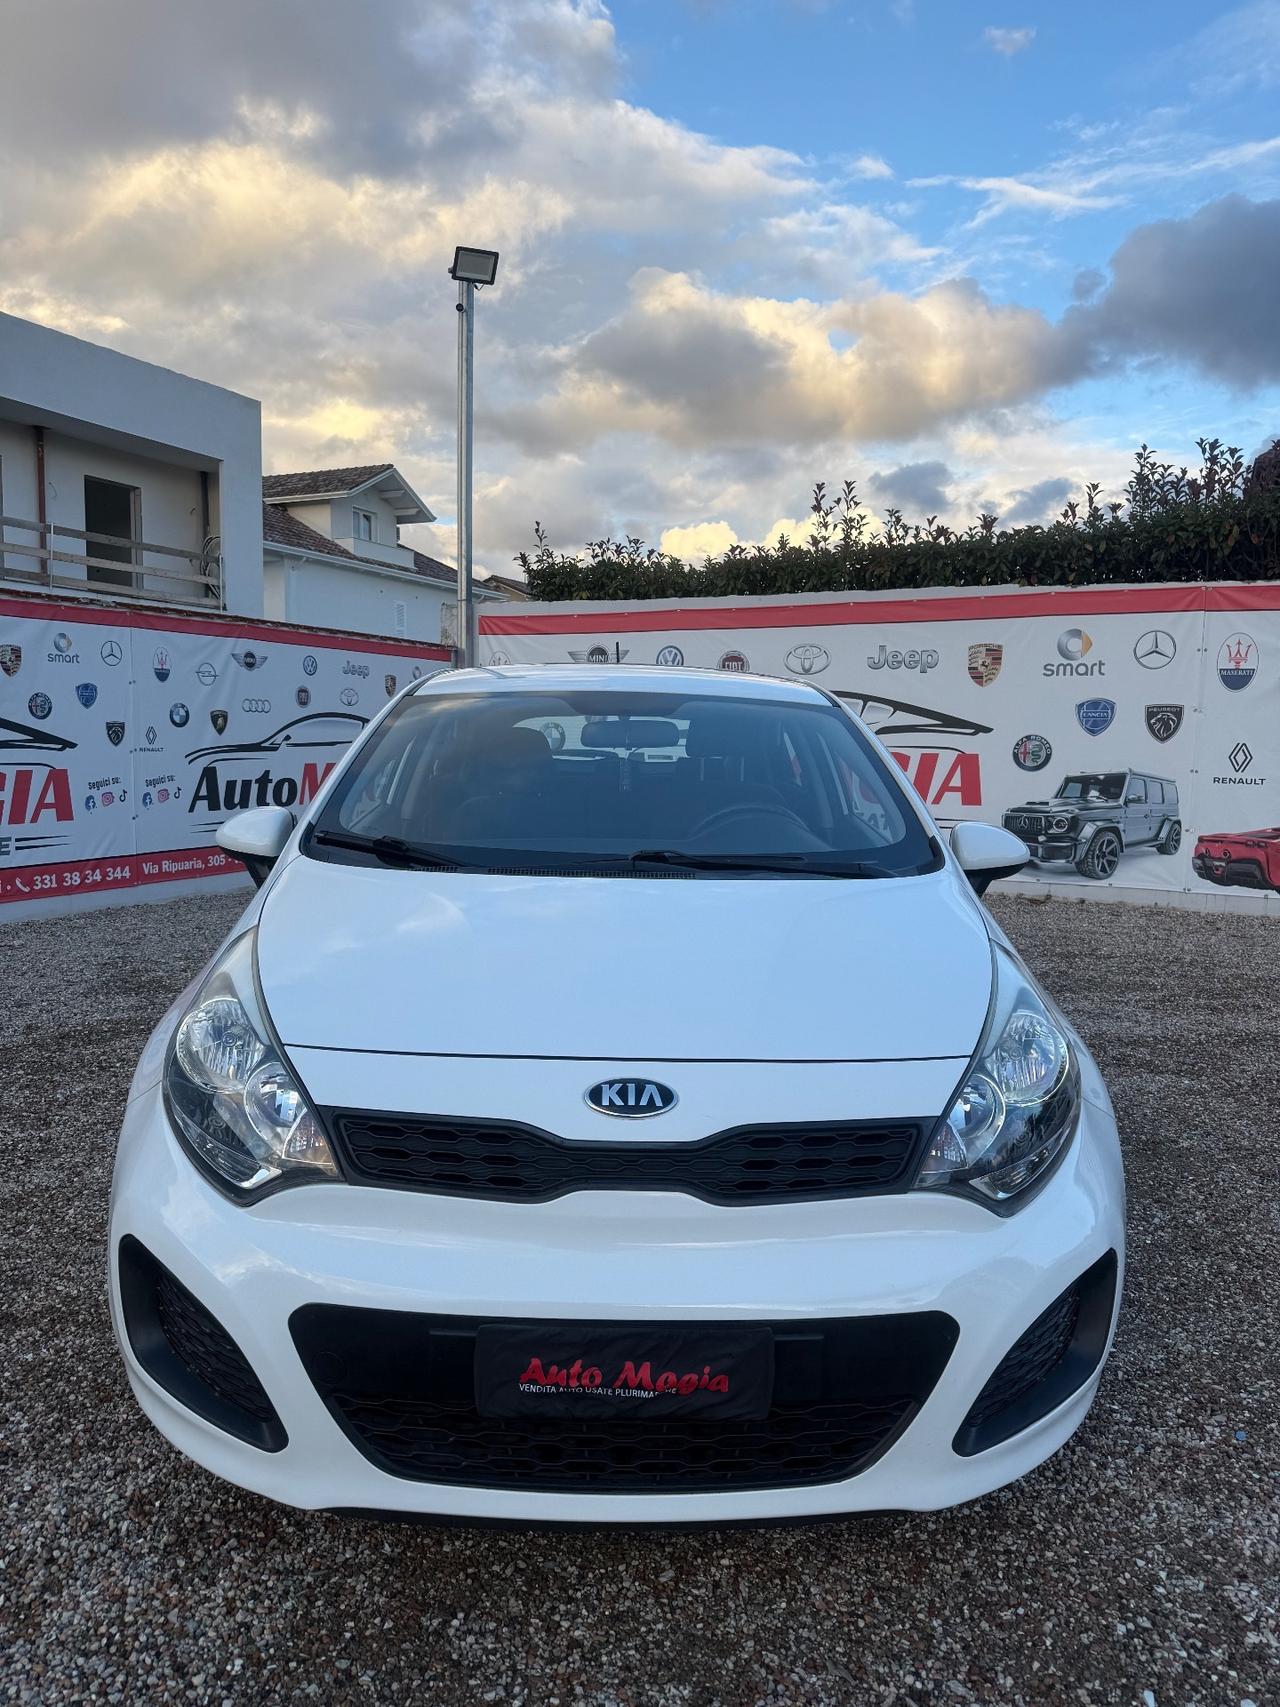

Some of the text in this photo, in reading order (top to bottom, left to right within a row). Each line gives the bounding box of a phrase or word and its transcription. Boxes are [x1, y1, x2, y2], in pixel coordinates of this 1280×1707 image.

[47, 653, 80, 664] smart
[867, 644, 939, 673] Jeep
[342, 660, 370, 679] Jeep
[1042, 660, 1106, 677] smart
[1219, 668, 1254, 676] MASERATI
[1082, 711, 1108, 719] LANCIA
[1213, 776, 1267, 786] RENAULT
[143, 861, 159, 875] Via
[162, 857, 205, 873] Ripuaria,
[207, 854, 226, 867] 305
[33, 865, 131, 890] 331 38 34 344
[601, 1083, 663, 1107] KIA
[519, 1357, 730, 1396] Auto Magia
[519, 1383, 557, 1393] VENDITA
